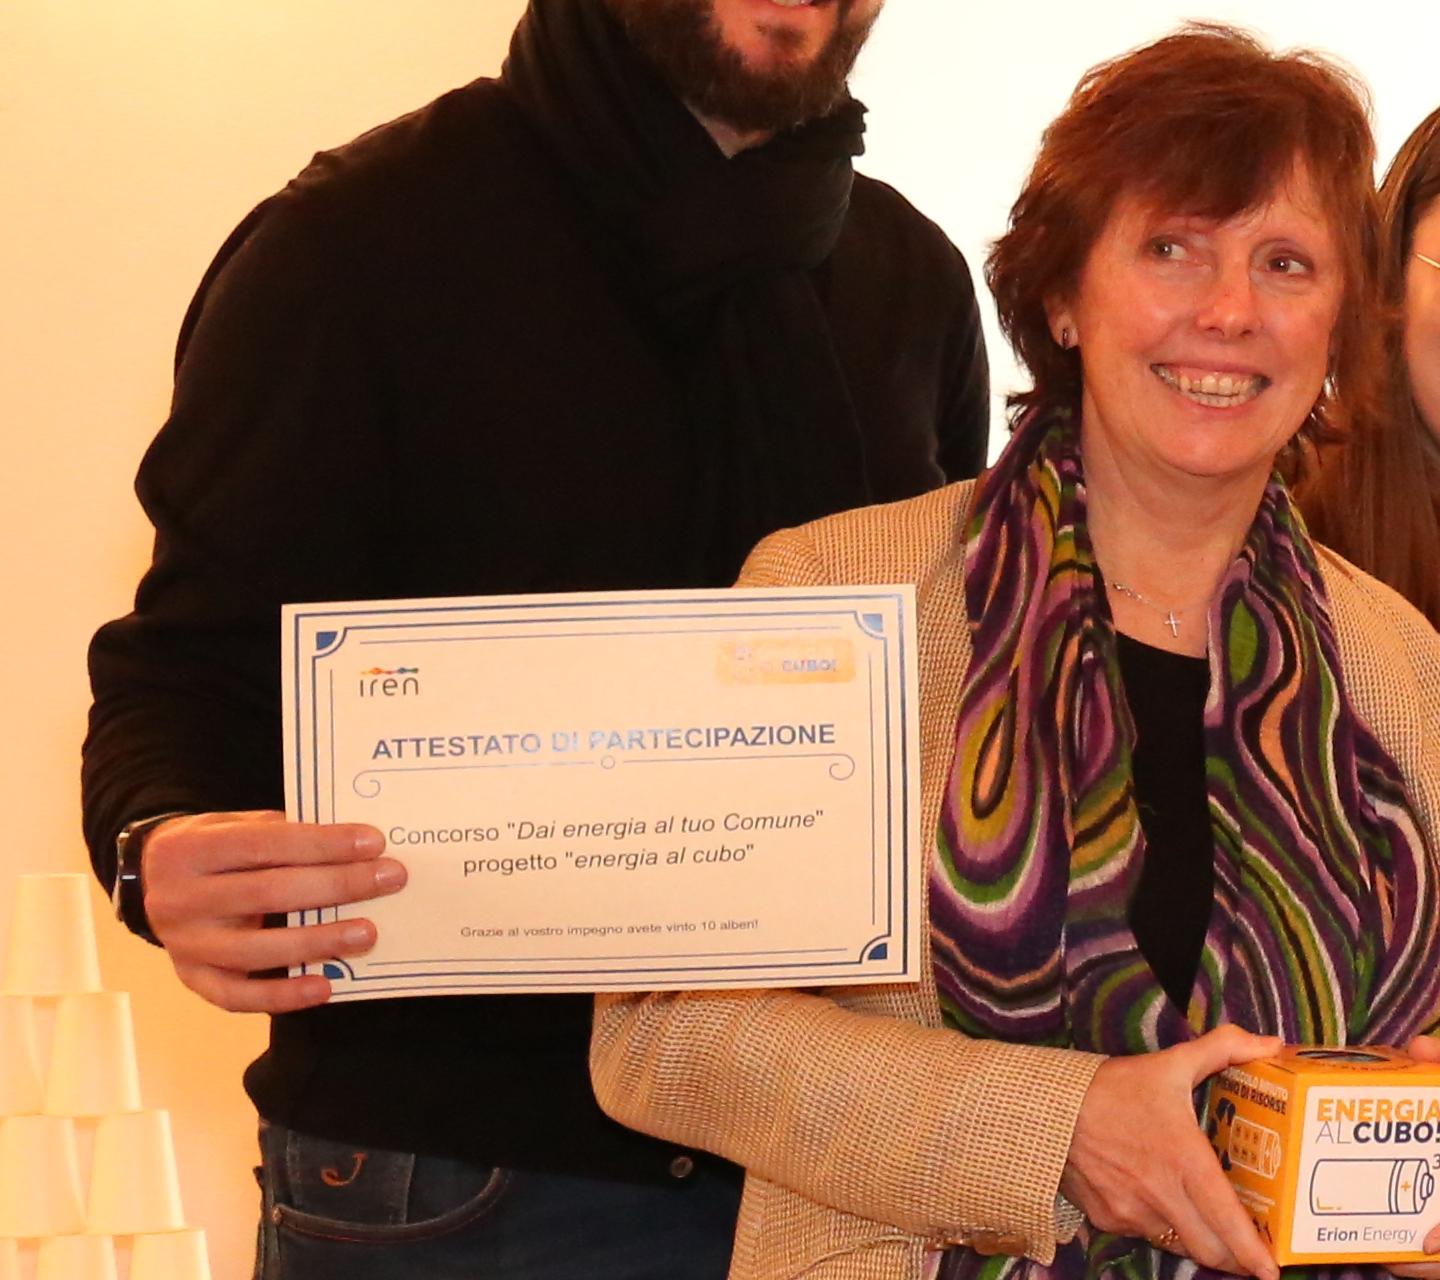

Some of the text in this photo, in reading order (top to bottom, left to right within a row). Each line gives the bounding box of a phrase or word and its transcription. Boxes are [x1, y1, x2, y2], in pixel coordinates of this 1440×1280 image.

[371, 723, 836, 760] ATTESTATO DI PARTECIPAZIONE
[388, 809, 824, 845] Concorso "Dai energia al tuo Comune"
[463, 843, 755, 877] progetto "energia al cubo"
[460, 926, 504, 938] Grazie
[507, 927, 520, 937] al
[522, 926, 564, 937] vostro
[566, 923, 623, 937] impegno
[626, 923, 662, 934] avete
[665, 921, 697, 932] vinto
[701, 920, 717, 931] 10
[1316, 1226, 1417, 1244] Erion Energy
